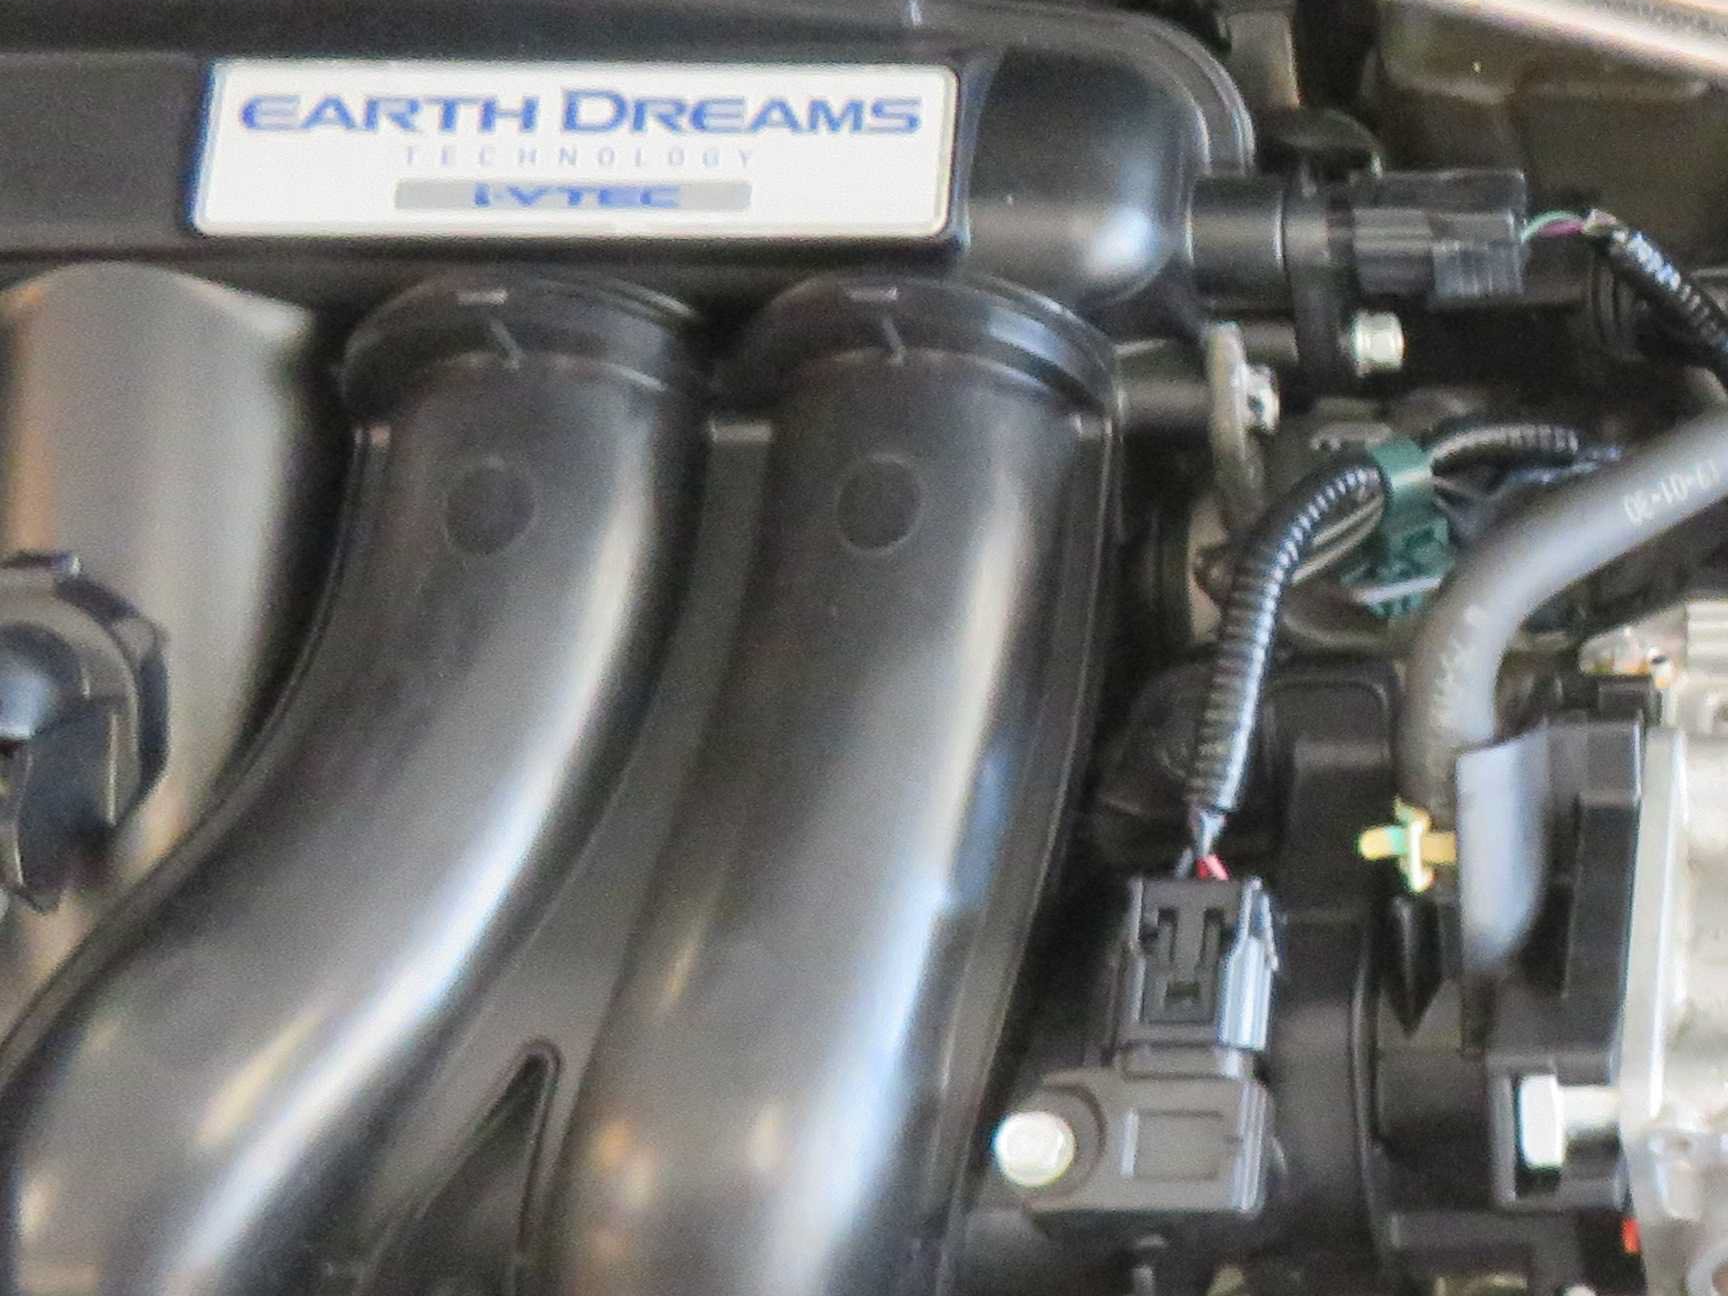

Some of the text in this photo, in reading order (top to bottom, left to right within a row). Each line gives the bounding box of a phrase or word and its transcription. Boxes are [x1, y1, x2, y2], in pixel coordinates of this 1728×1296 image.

[241, 88, 921, 135] EARTH DREAMS
[402, 145, 757, 167] TECHNOLOGY
